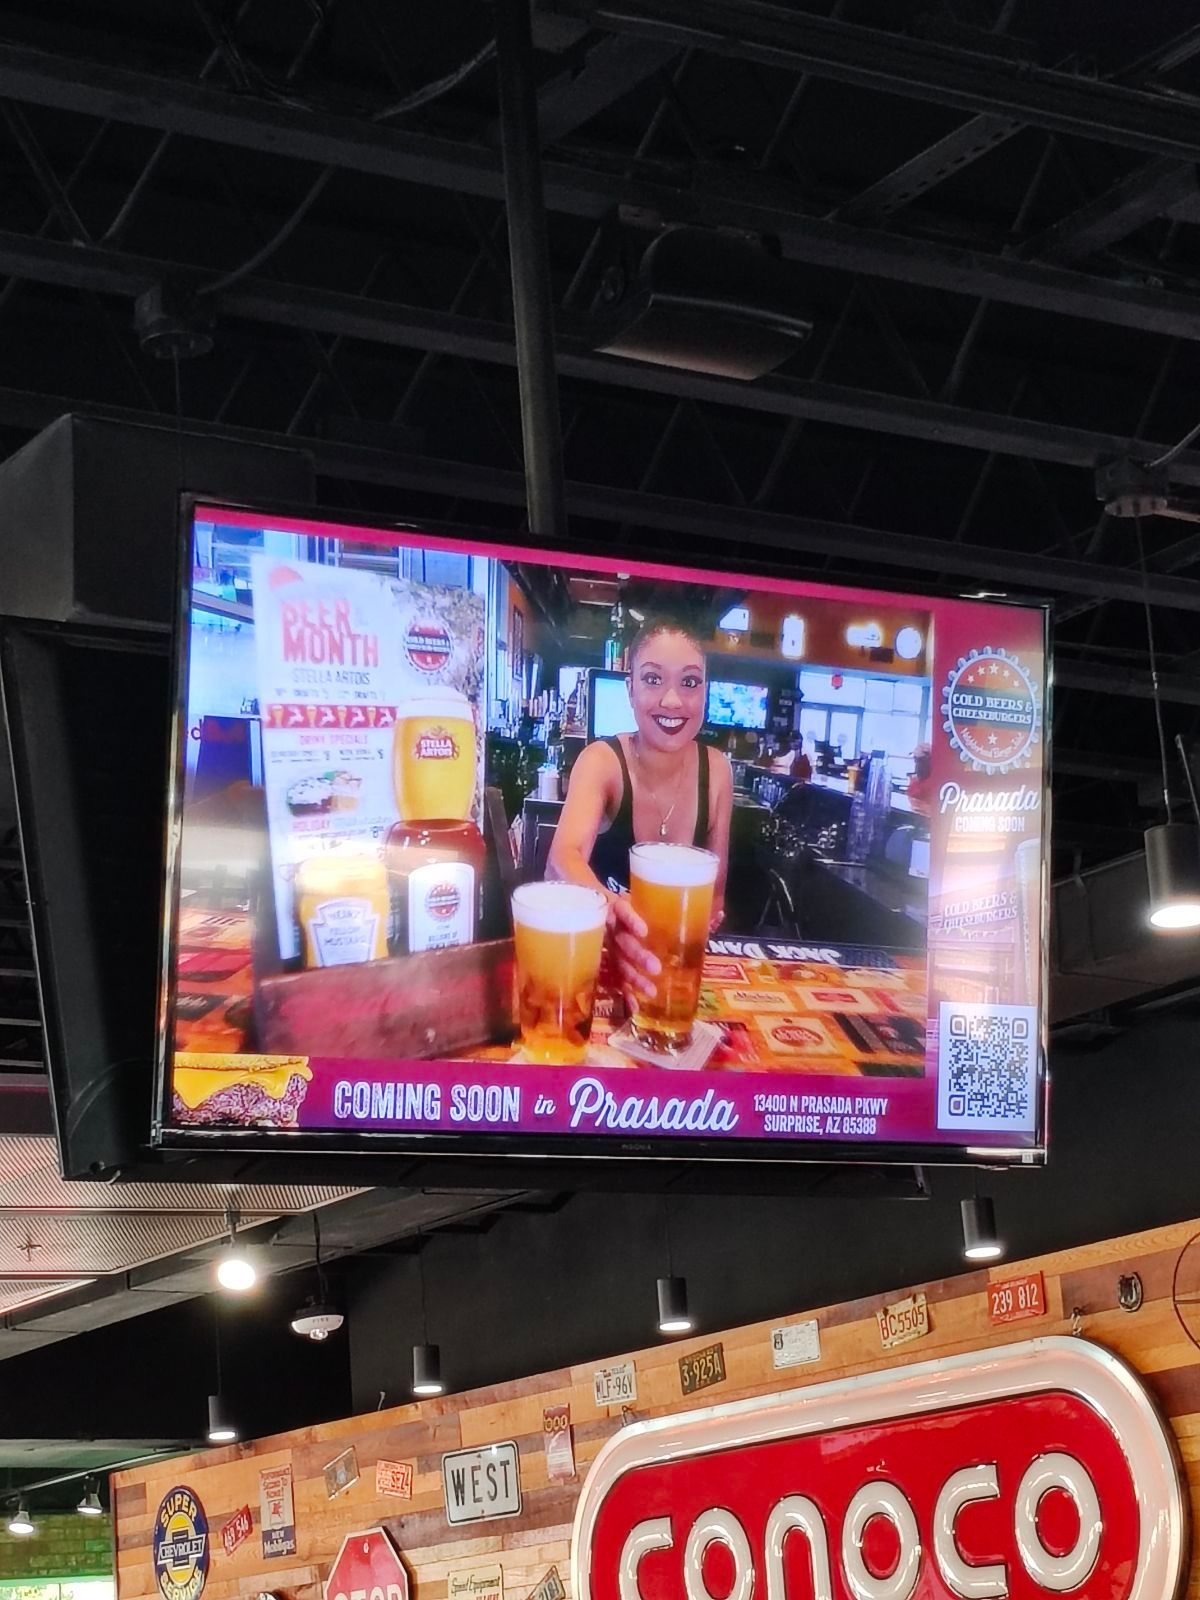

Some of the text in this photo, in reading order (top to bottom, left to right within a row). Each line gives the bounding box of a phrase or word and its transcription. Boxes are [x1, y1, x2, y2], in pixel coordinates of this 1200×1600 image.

[283, 623, 380, 668] MONTH
[952, 693, 1033, 713] COLD BEERS &
[952, 707, 1033, 725] CHEESEBURGERS
[420, 739, 453, 749] STELLA
[939, 782, 1040, 814] Prasada
[955, 816, 1025, 833] COMING SOON
[943, 906, 1018, 930] CHEESEBURGERS
[944, 902, 970, 918] COLD
[972, 892, 1008, 914] BEERS
[334, 1077, 739, 1132] COMING SOON in Prasada
[753, 1093, 889, 1116] 13400 N PRASADA PKWY
[763, 1114, 877, 1136] SURPRISE, AZ 85388
[991, 1283, 1039, 1316] 239 812
[451, 1460, 510, 1507] WEST
[161, 1493, 198, 1528] SUPER
[618, 1450, 1102, 1600] conoco
[160, 1539, 203, 1560] CHEVROLET
[160, 1565, 204, 1600] SERVICE
